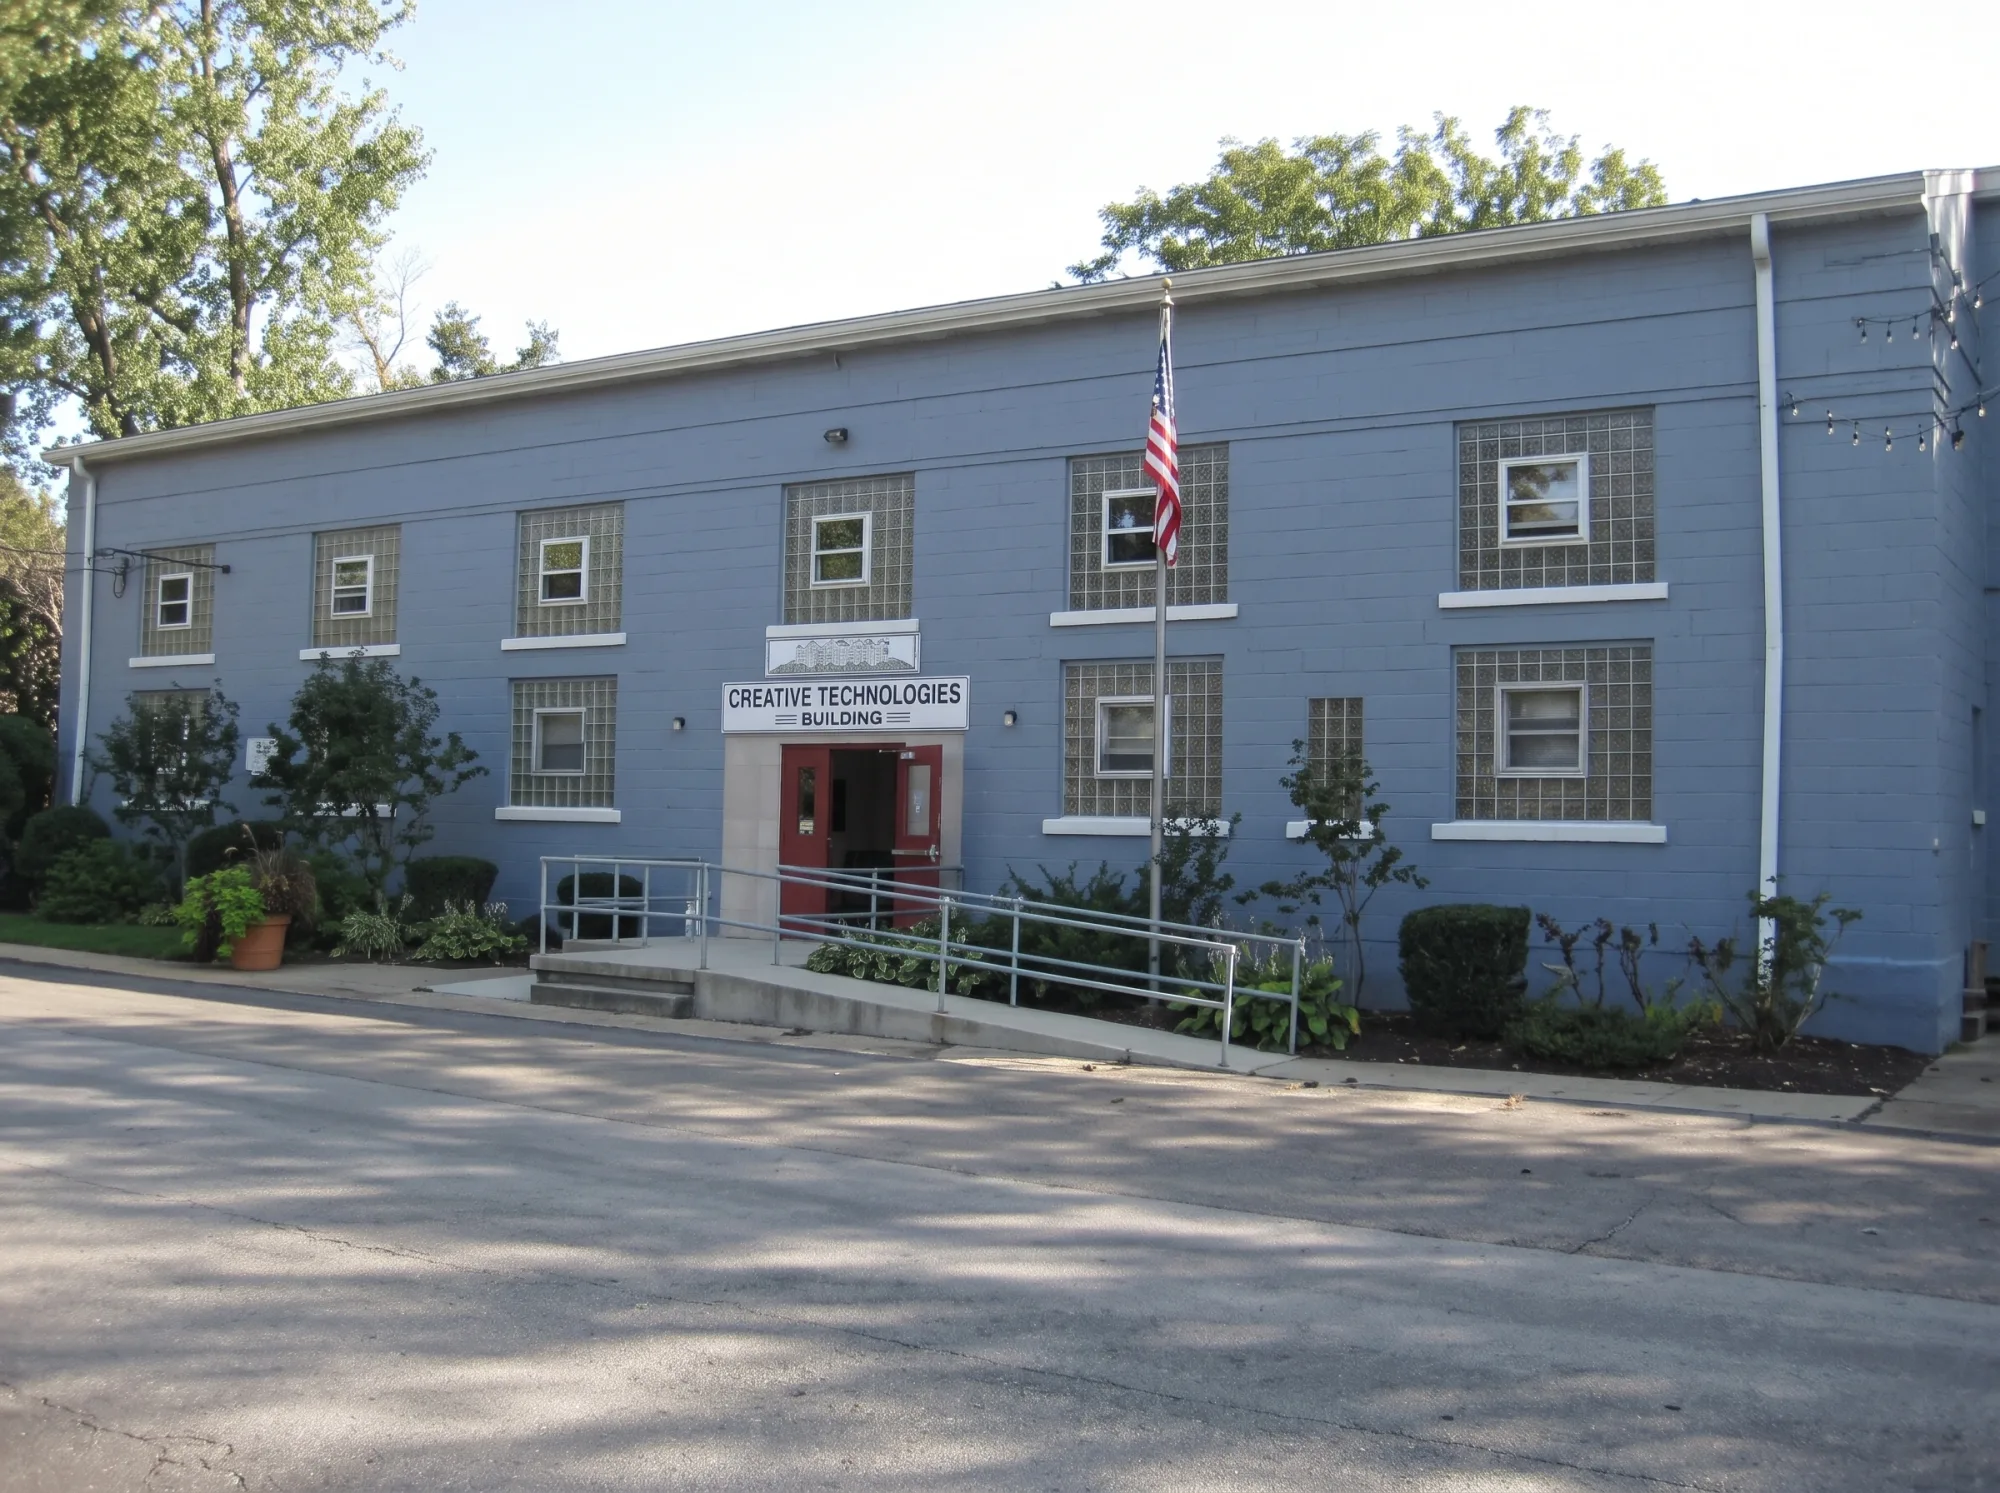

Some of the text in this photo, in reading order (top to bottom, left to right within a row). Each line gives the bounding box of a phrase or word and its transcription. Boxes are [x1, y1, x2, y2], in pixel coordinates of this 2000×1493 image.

[729, 683, 961, 708] CREATIVE TECHNOLOGIES
[802, 711, 882, 726] BUILDING
